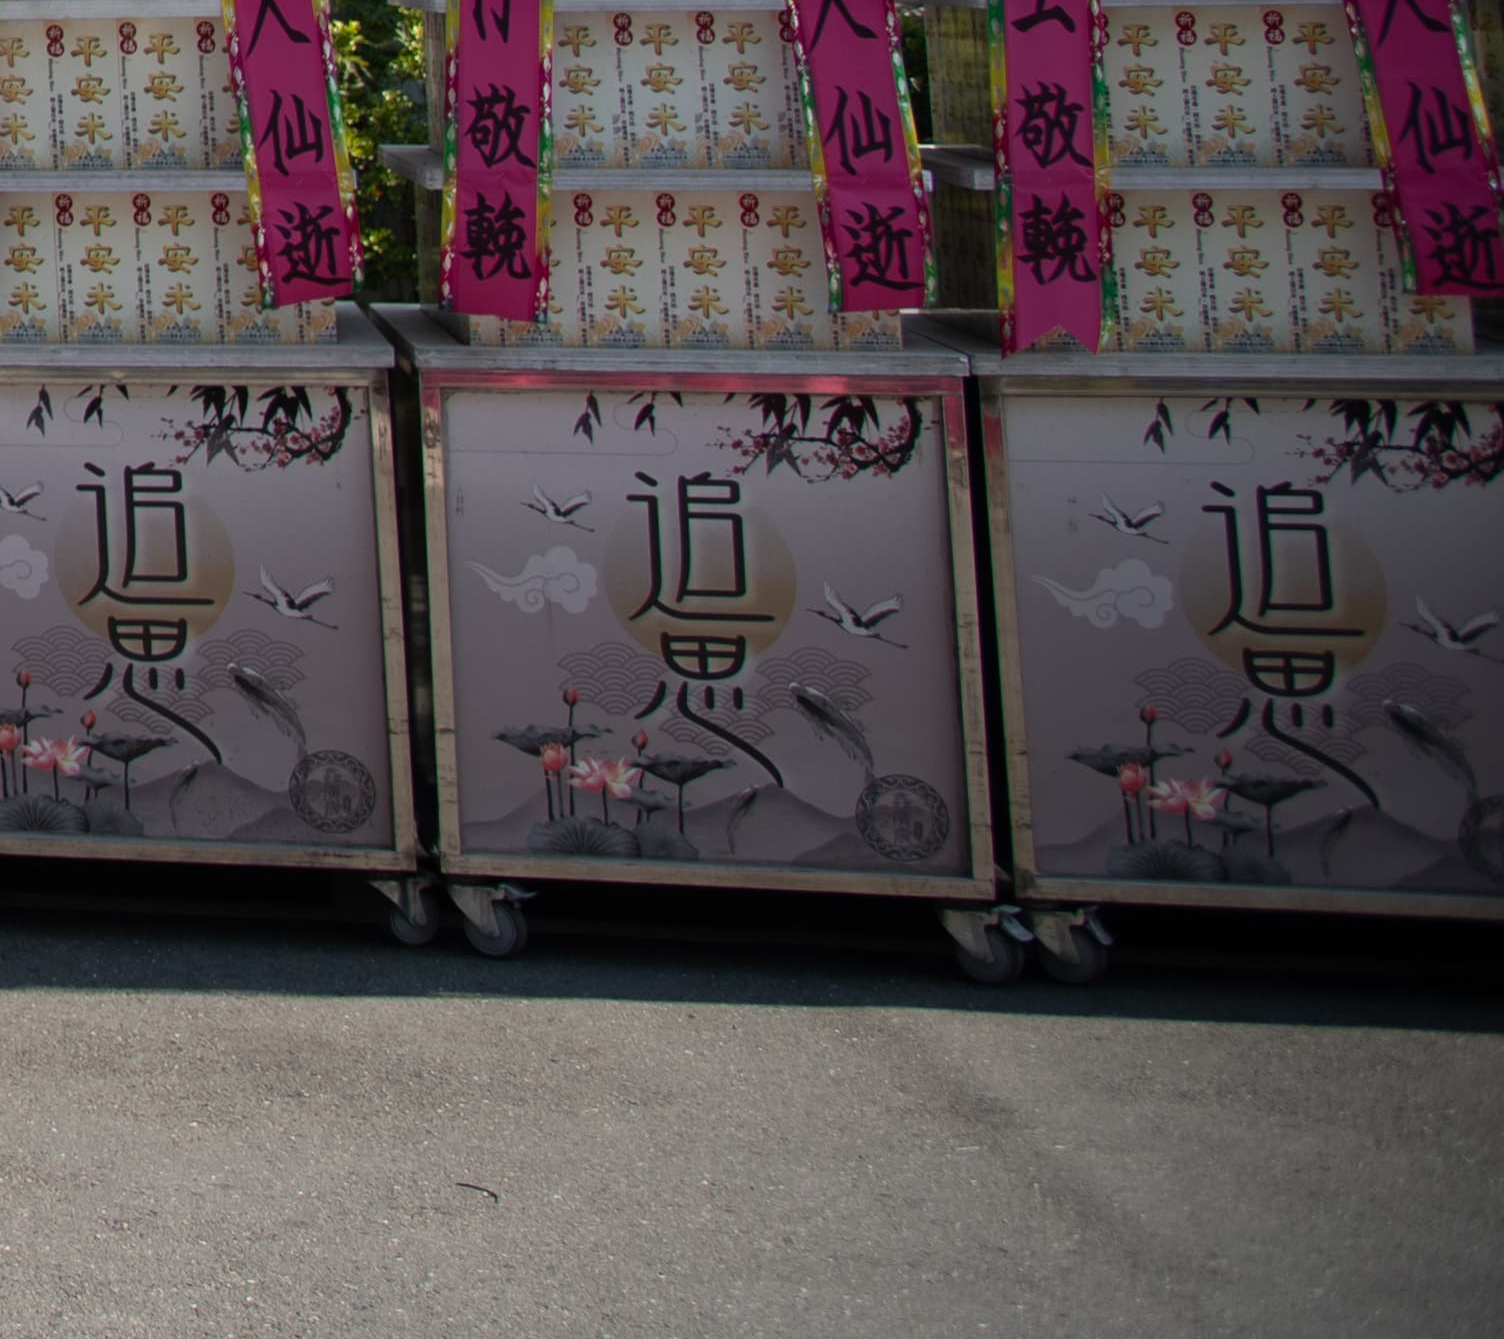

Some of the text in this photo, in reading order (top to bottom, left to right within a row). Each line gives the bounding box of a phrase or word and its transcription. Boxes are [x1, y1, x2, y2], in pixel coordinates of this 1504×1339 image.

[1117, 21, 1168, 139] 平安米
[1175, 10, 1196, 45] 祈福
[1205, 20, 1256, 138] 平安米
[1263, 9, 1284, 44] 祈福
[156, 204, 203, 313] 平安米
[572, 192, 593, 227] 祈福
[655, 192, 676, 227] 祈福
[738, 192, 759, 227] 祈福
[1133, 203, 1184, 321] 平安米
[1192, 192, 1213, 227] 祈福
[1222, 203, 1273, 321] 平安米
[1281, 192, 1302, 227] 祈福
[1312, 203, 1363, 321] 平安米
[77, 462, 223, 764] 追思
[627, 470, 782, 789] 追思
[1200, 481, 1379, 811] 追思
